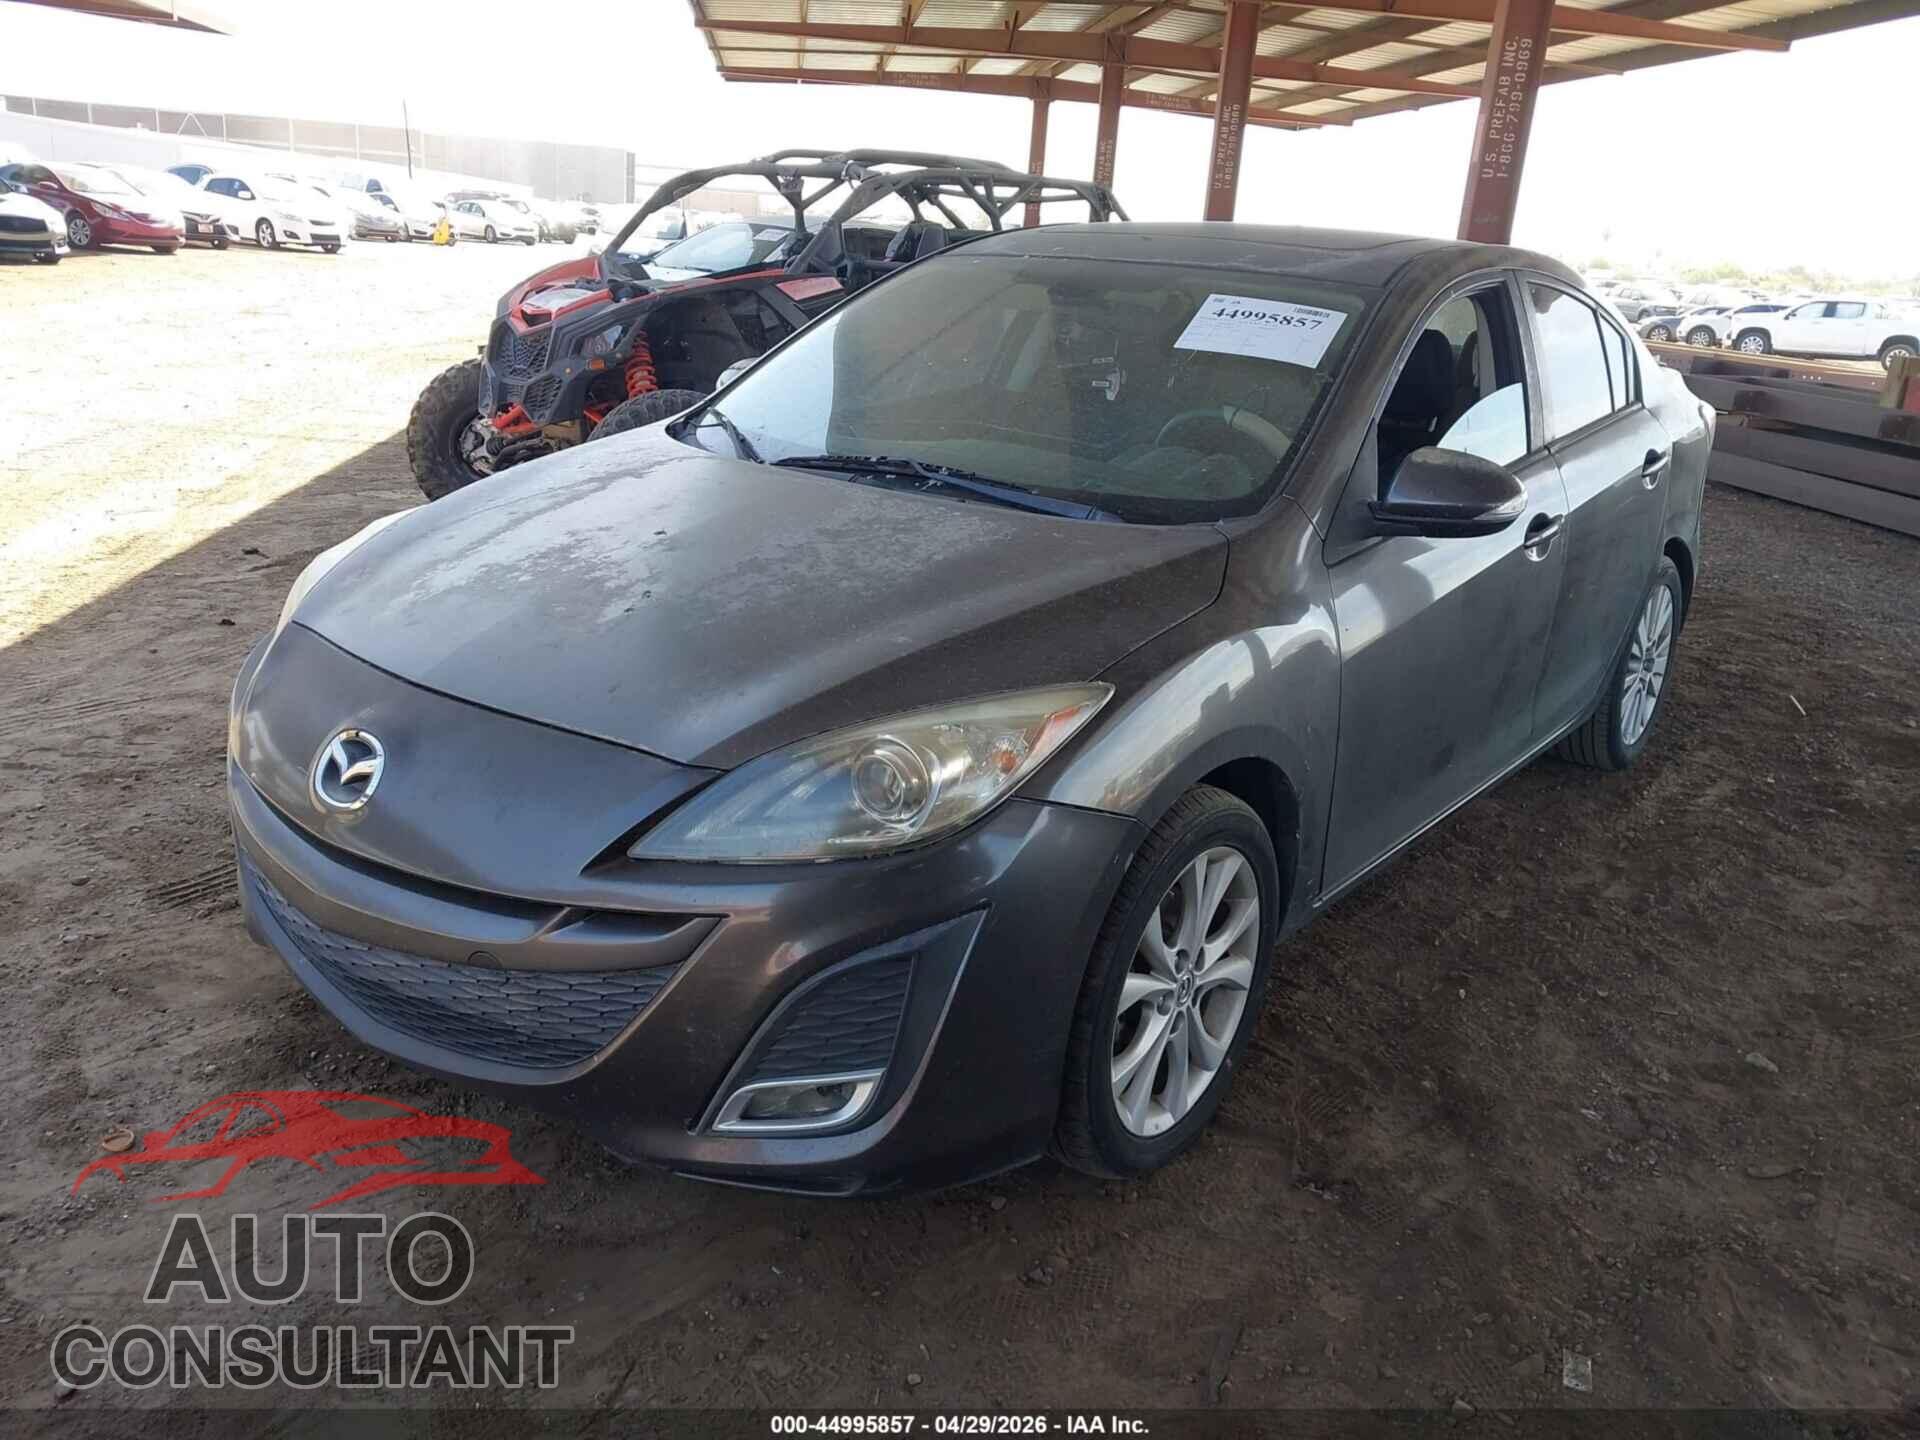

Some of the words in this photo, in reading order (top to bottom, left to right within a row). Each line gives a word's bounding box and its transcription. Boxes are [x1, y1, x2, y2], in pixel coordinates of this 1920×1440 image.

[1489, 75, 1511, 139] PREFAB
[1502, 35, 1519, 67] INC.
[1212, 307, 1323, 330] 44995857
